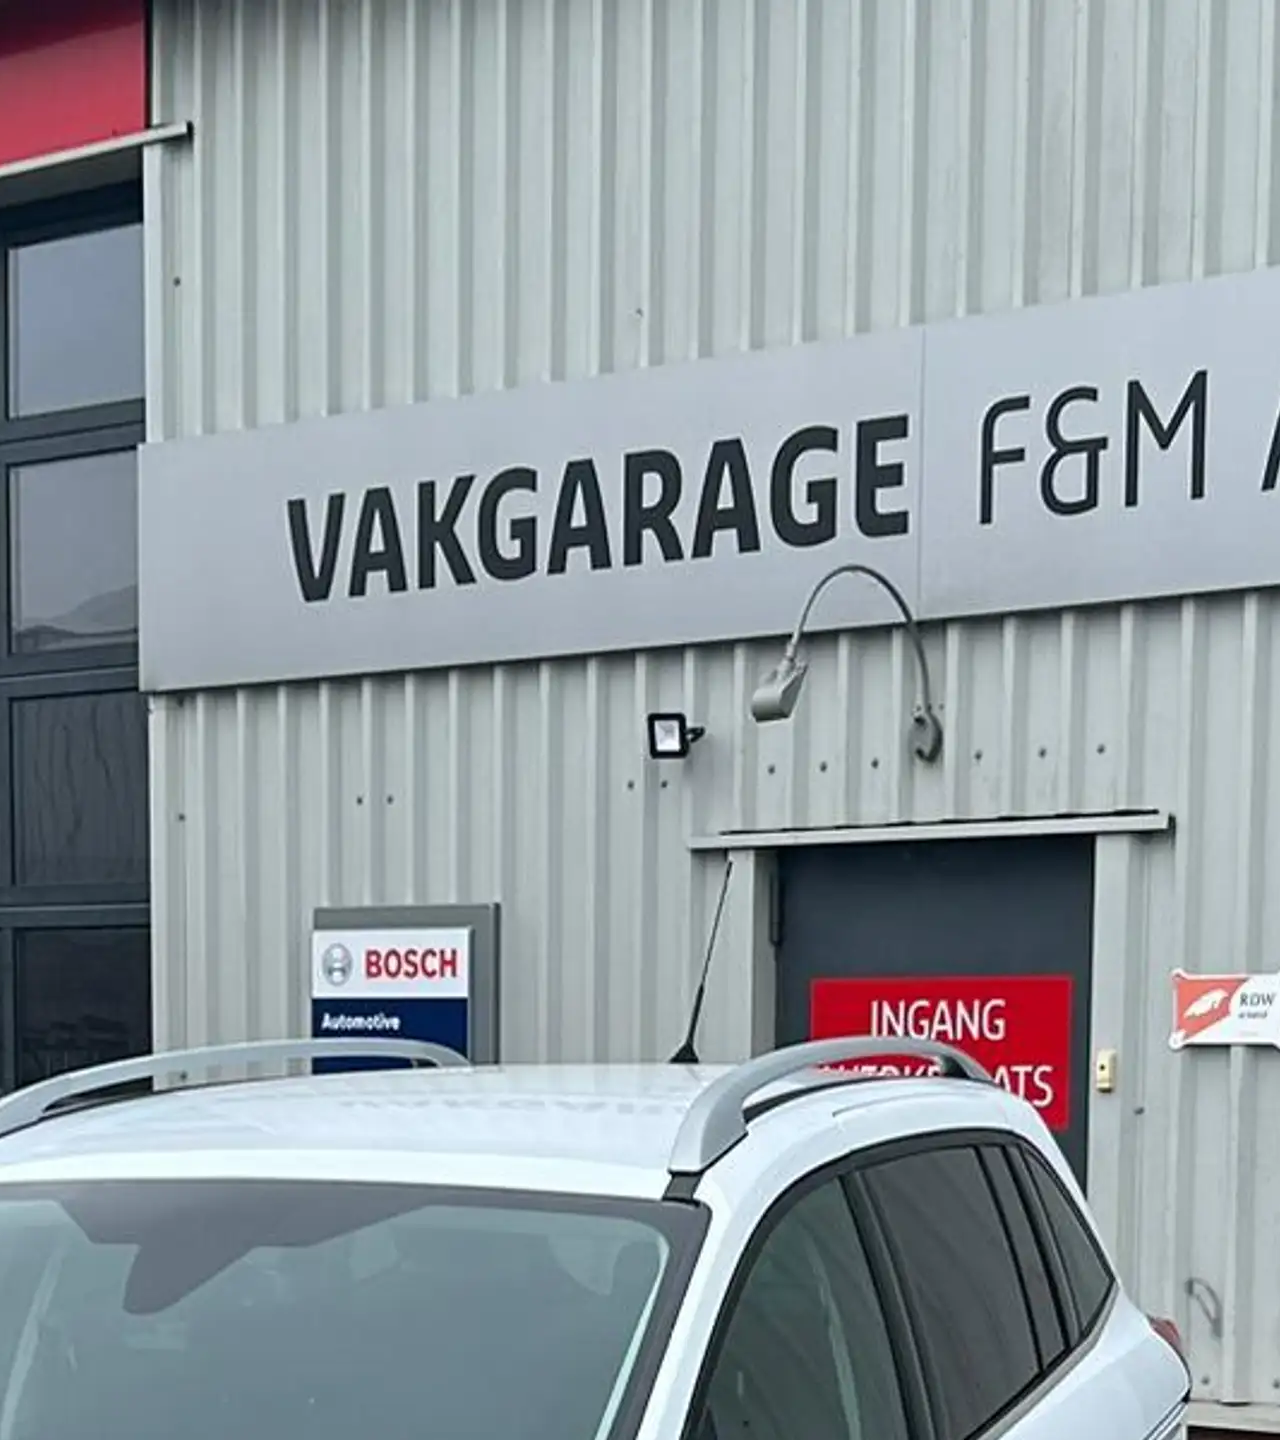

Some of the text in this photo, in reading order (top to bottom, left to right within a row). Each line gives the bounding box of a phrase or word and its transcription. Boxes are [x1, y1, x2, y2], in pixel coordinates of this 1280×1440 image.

[286, 413, 910, 603] VAKGARAGE
[978, 369, 1208, 525] F&M
[365, 948, 458, 979] BOSCH
[321, 1012, 401, 1031] Automotive
[871, 999, 1006, 1041] INGANG
